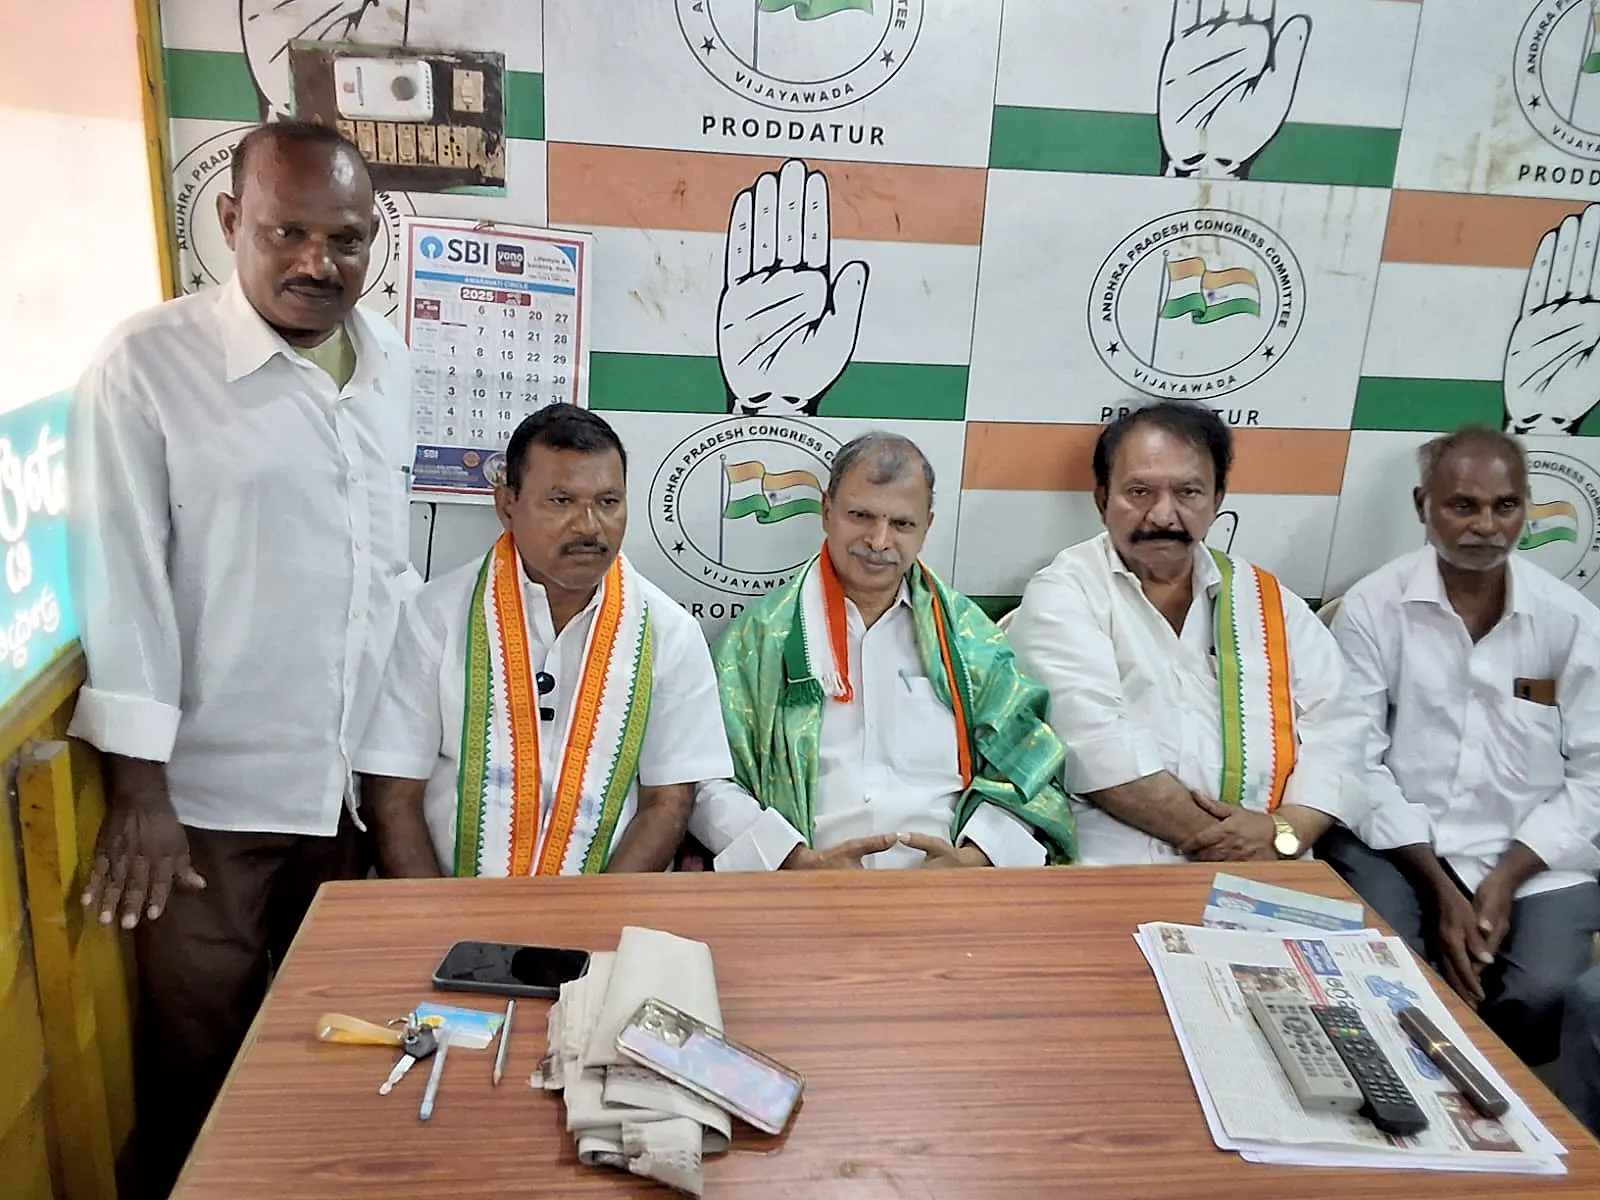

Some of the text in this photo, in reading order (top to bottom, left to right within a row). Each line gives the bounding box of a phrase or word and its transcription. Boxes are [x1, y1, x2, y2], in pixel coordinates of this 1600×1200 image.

[1527, 11, 1556, 74] ANDHRA
[734, 71, 855, 103] VIJAYAWADA
[701, 115, 885, 146] PRODDATUR
[1552, 124, 1600, 152] VIJAYA
[192, 143, 236, 181] PRADE
[1518, 164, 1600, 186] PRODD
[447, 238, 489, 265] SBI
[497, 250, 524, 263] yono
[1102, 218, 1293, 329] ANDHRA PRADESH CONGRESS COMMITTEE
[462, 288, 494, 301] 2025
[478, 305, 568, 323] 6 13 20 27
[478, 327, 567, 344] 7 14 21 28
[450, 345, 566, 364] 1 8 15 22 29
[448, 366, 566, 384] 2 9 16 23 30
[1133, 367, 1237, 393] VIJAYAWADA
[447, 386, 563, 403] 3 10 17 24 31
[447, 407, 511, 420] 4 11 18
[1100, 406, 1260, 425] PRTUR
[447, 427, 510, 440] 5 12 19
[663, 425, 824, 523] ANDHRA PRADESH CONGRESS
[703, 566, 795, 589] VIJAYAWA
